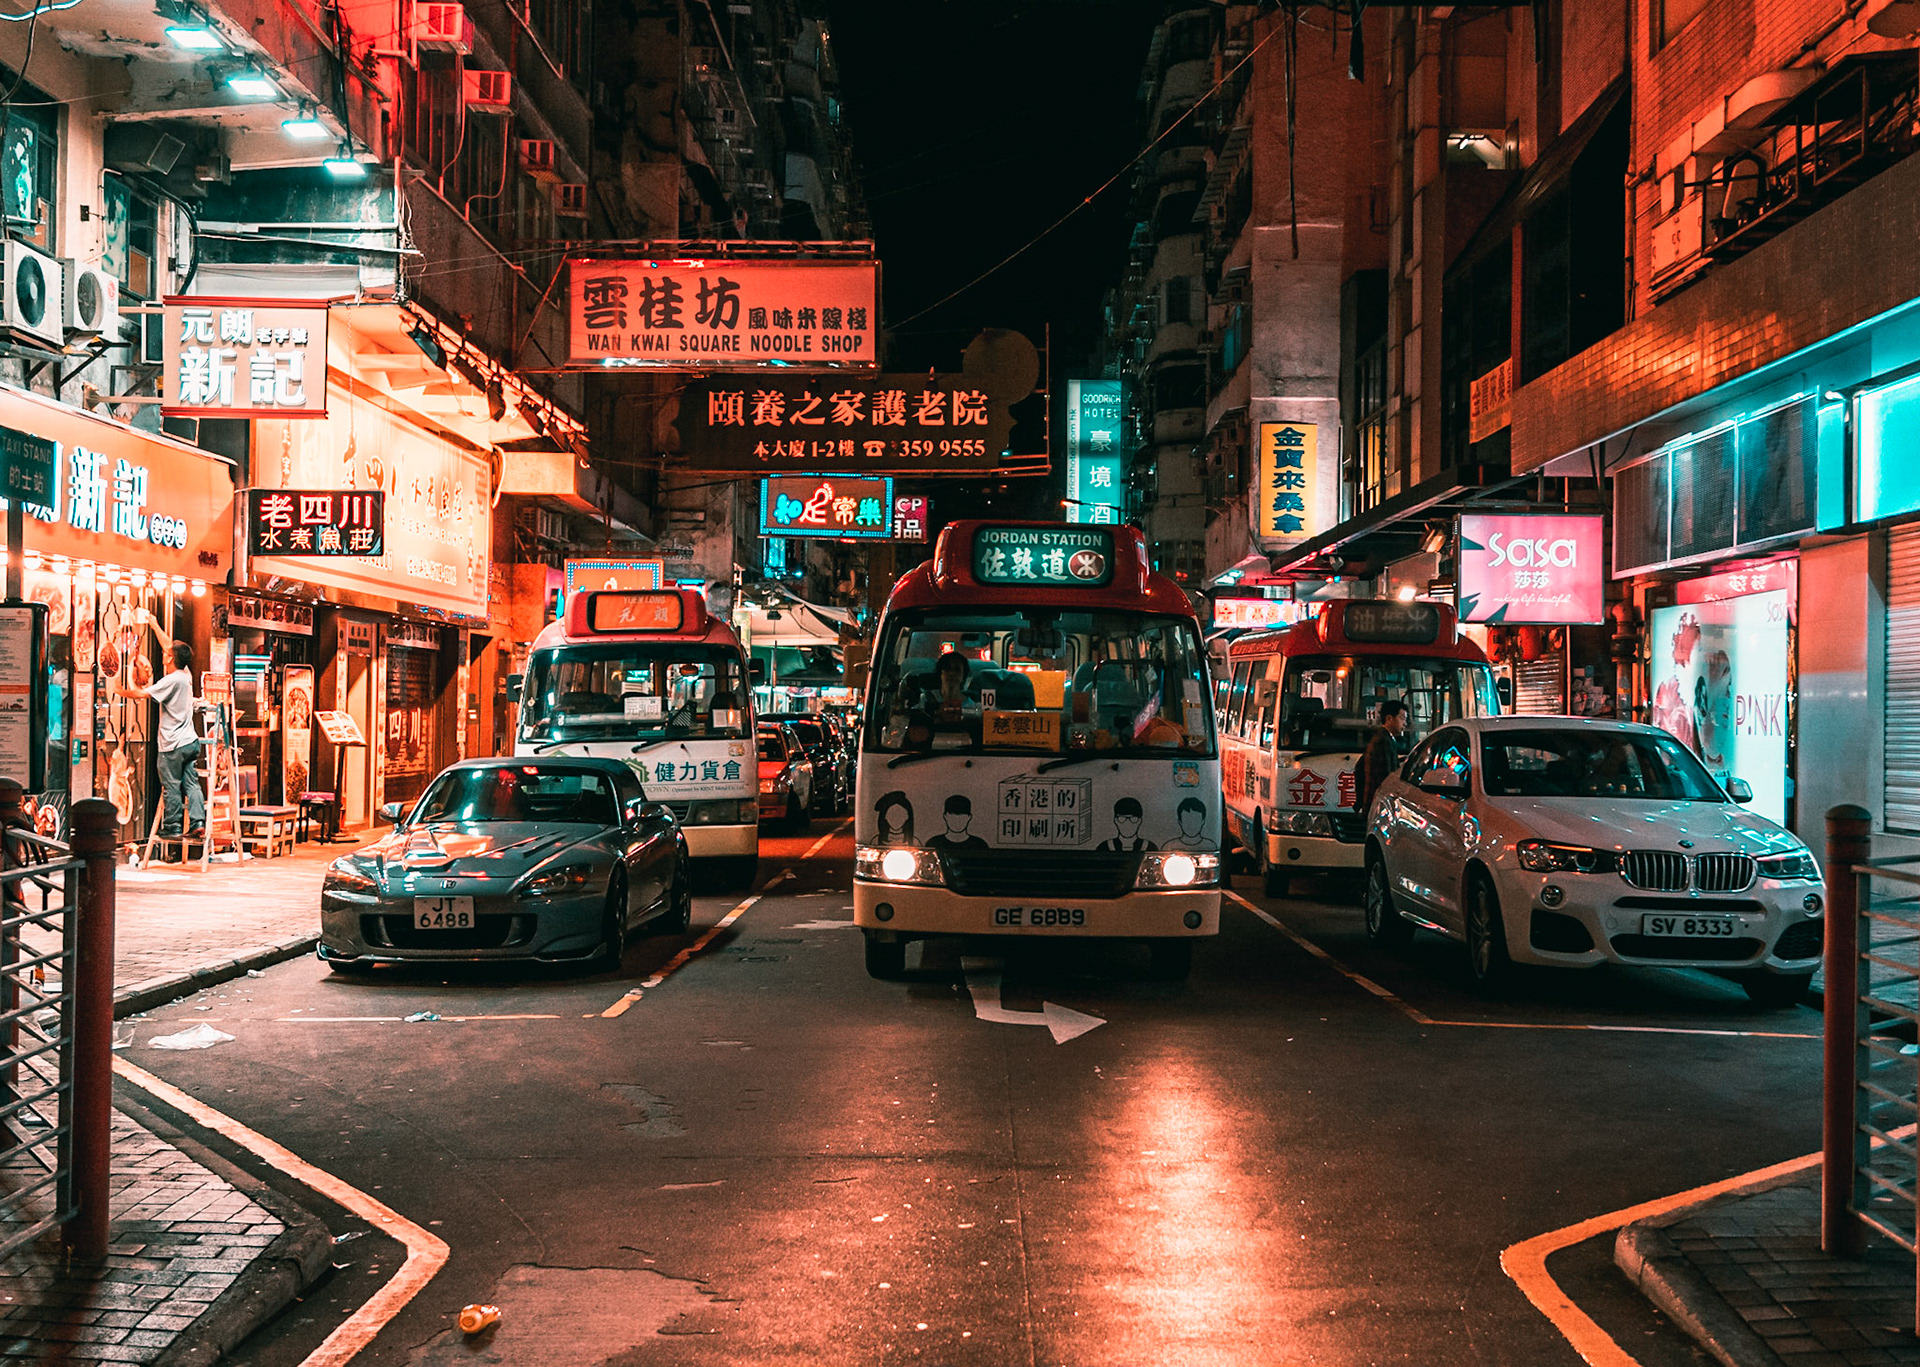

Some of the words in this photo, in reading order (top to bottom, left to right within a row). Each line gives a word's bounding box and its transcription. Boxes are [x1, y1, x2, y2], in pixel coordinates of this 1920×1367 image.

[583, 276, 741, 330] 雲桂坊
[180, 308, 254, 343] 元朗
[588, 334, 621, 351] WAN
[631, 334, 670, 351] KWAI
[680, 334, 740, 352] SQUARE
[751, 334, 812, 352] NOODLE
[821, 335, 862, 352] SHOP
[179, 346, 306, 406] 新記
[1082, 393, 1121, 404] GOODRICH
[707, 389, 988, 427] 頤養之家護老院
[1084, 408, 1118, 418] HOTEL
[2, 437, 21, 455] TAXI
[23, 442, 52, 464] STAND
[753, 440, 806, 458] 本大廈
[898, 440, 934, 457] 359
[939, 440, 986, 457] 9555
[9, 464, 44, 494] 的士站
[260, 495, 374, 529] 老四川
[774, 482, 882, 526] 知足常樂
[260, 527, 375, 551] 水煮魚莊
[981, 532, 1039, 544] JORDAN
[1042, 533, 1102, 546] STATION
[981, 547, 1068, 580] 佐敦道
[1514, 571, 1550, 589] 莎莎
[623, 596, 643, 604] YUEN
[645, 596, 665, 604] LONG
[1492, 594, 1520, 606] making
[1521, 593, 1535, 604] life
[619, 606, 668, 623] 元朗
[982, 693, 995, 706] 10
[992, 716, 1050, 734] 慈雲山
[655, 760, 741, 782] 健力貨倉
[1004, 789, 1076, 808] 香港的
[1002, 819, 1075, 839] 印刷所
[432, 898, 456, 911] JT
[420, 913, 469, 927] 6488
[995, 909, 1022, 925] GE
[1030, 909, 1085, 925] 6889
[1652, 918, 1675, 933] SV
[1684, 919, 1733, 935] 8333
